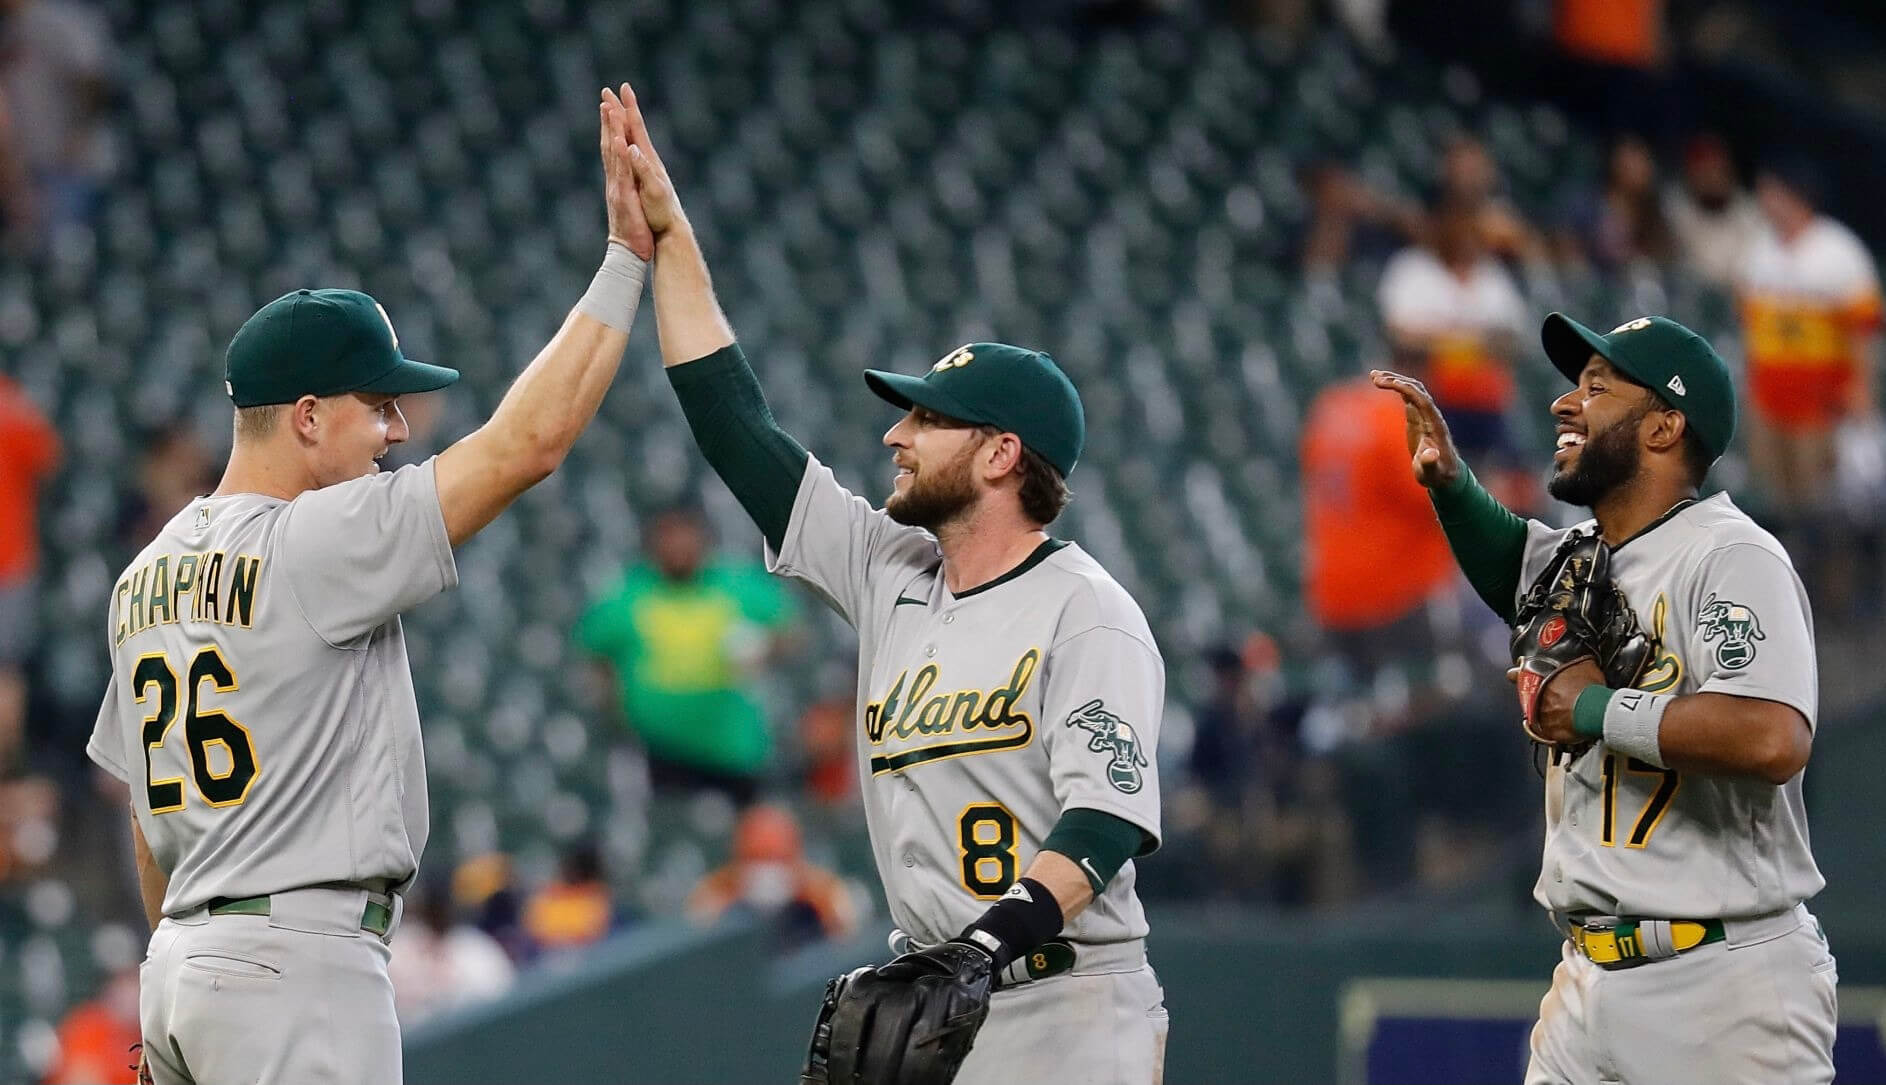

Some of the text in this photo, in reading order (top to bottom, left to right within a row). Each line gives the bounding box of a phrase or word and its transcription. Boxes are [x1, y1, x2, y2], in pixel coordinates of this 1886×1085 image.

[132, 645, 262, 816] 26
[866, 648, 1041, 750] akland
[1599, 754, 1680, 849] 17
[956, 802, 1020, 901] 8
[1032, 953, 1048, 970] 8
[1618, 936, 1636, 958] 17
